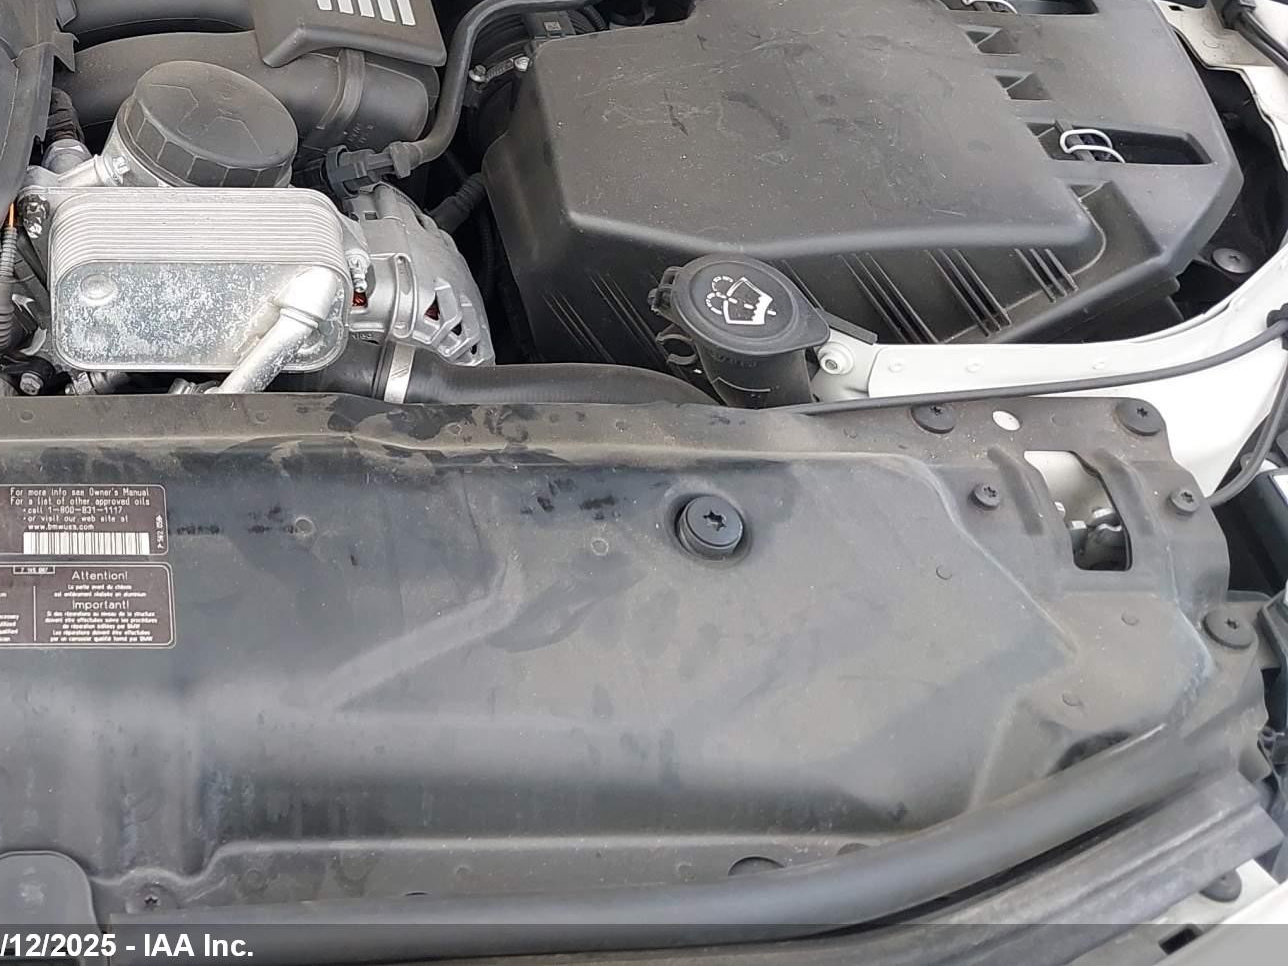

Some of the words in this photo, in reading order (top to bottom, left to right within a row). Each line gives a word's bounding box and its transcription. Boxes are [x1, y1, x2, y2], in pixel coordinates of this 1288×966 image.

[10, 488, 23, 496] For
[51, 488, 66, 496] info
[89, 487, 118, 496] Owner's
[123, 487, 149, 496] Manual
[10, 497, 23, 505] For
[38, 497, 51, 505] list
[57, 497, 65, 505] of
[70, 497, 90, 505] other
[95, 497, 130, 506] approved
[135, 497, 150, 505] oils
[72, 572, 128, 581] Attention!
[72, 600, 130, 611] Important!
